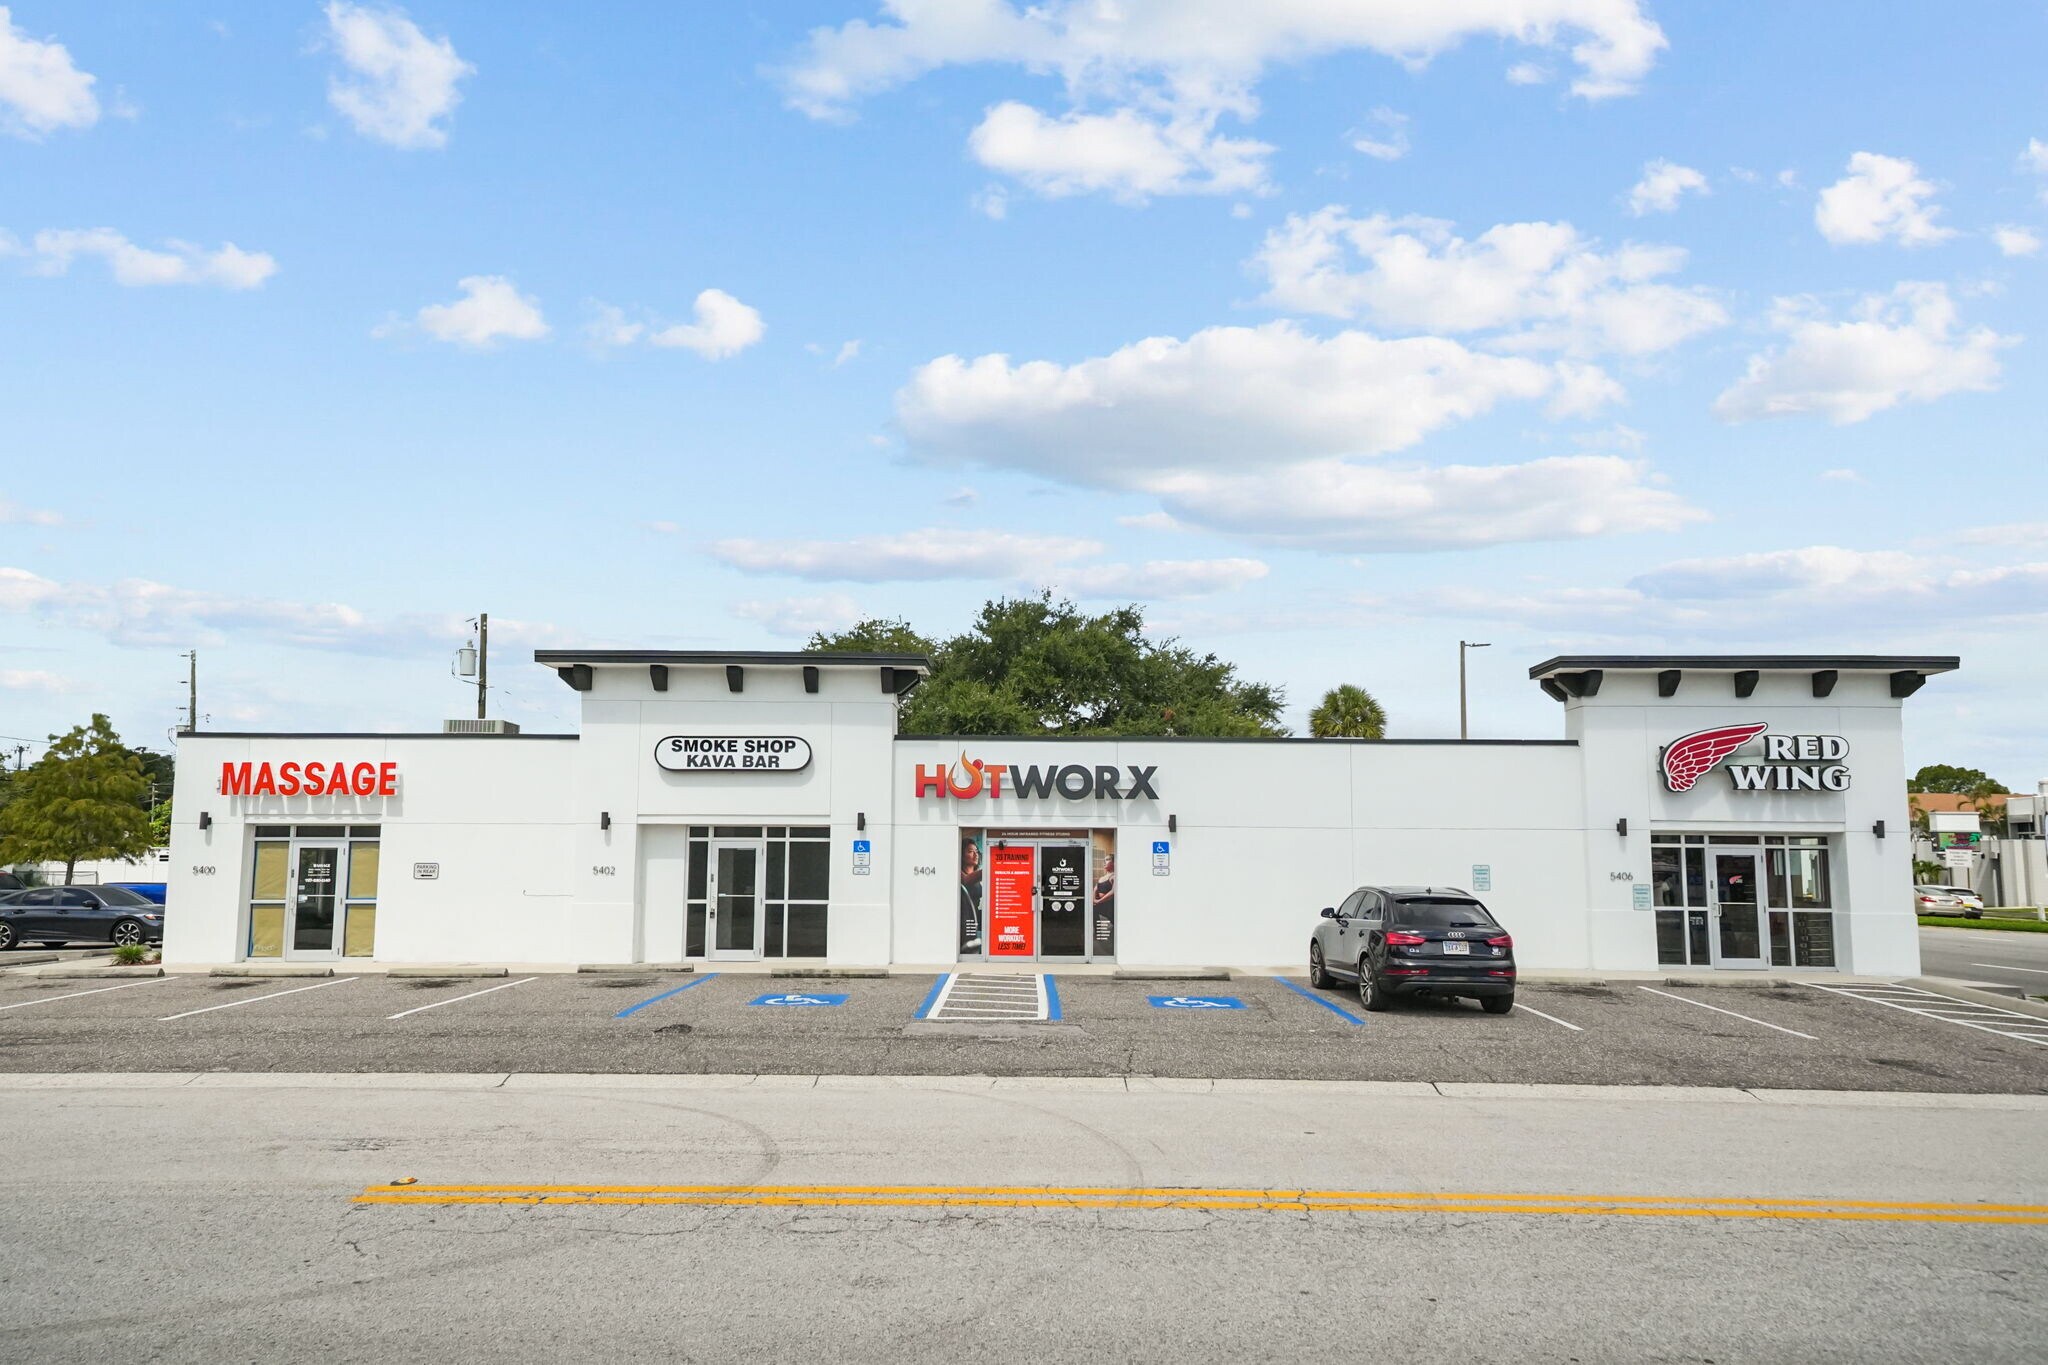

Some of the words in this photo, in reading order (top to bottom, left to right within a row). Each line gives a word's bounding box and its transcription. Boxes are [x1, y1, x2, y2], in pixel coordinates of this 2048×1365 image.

[671, 739, 738, 752] SMOKE
[744, 740, 796, 753] SHOP
[1764, 735, 1849, 760] RED
[686, 755, 736, 767] KAVA
[742, 755, 780, 768] BAR
[221, 762, 397, 796] MASSAGE
[915, 750, 1160, 800] HOTWORX
[1725, 765, 1851, 791] WING
[192, 865, 216, 876] 5400
[592, 865, 616, 876] 5402
[913, 866, 936, 876] 5404
[1610, 872, 1634, 881] 5406
[1004, 926, 1020, 934] MORE
